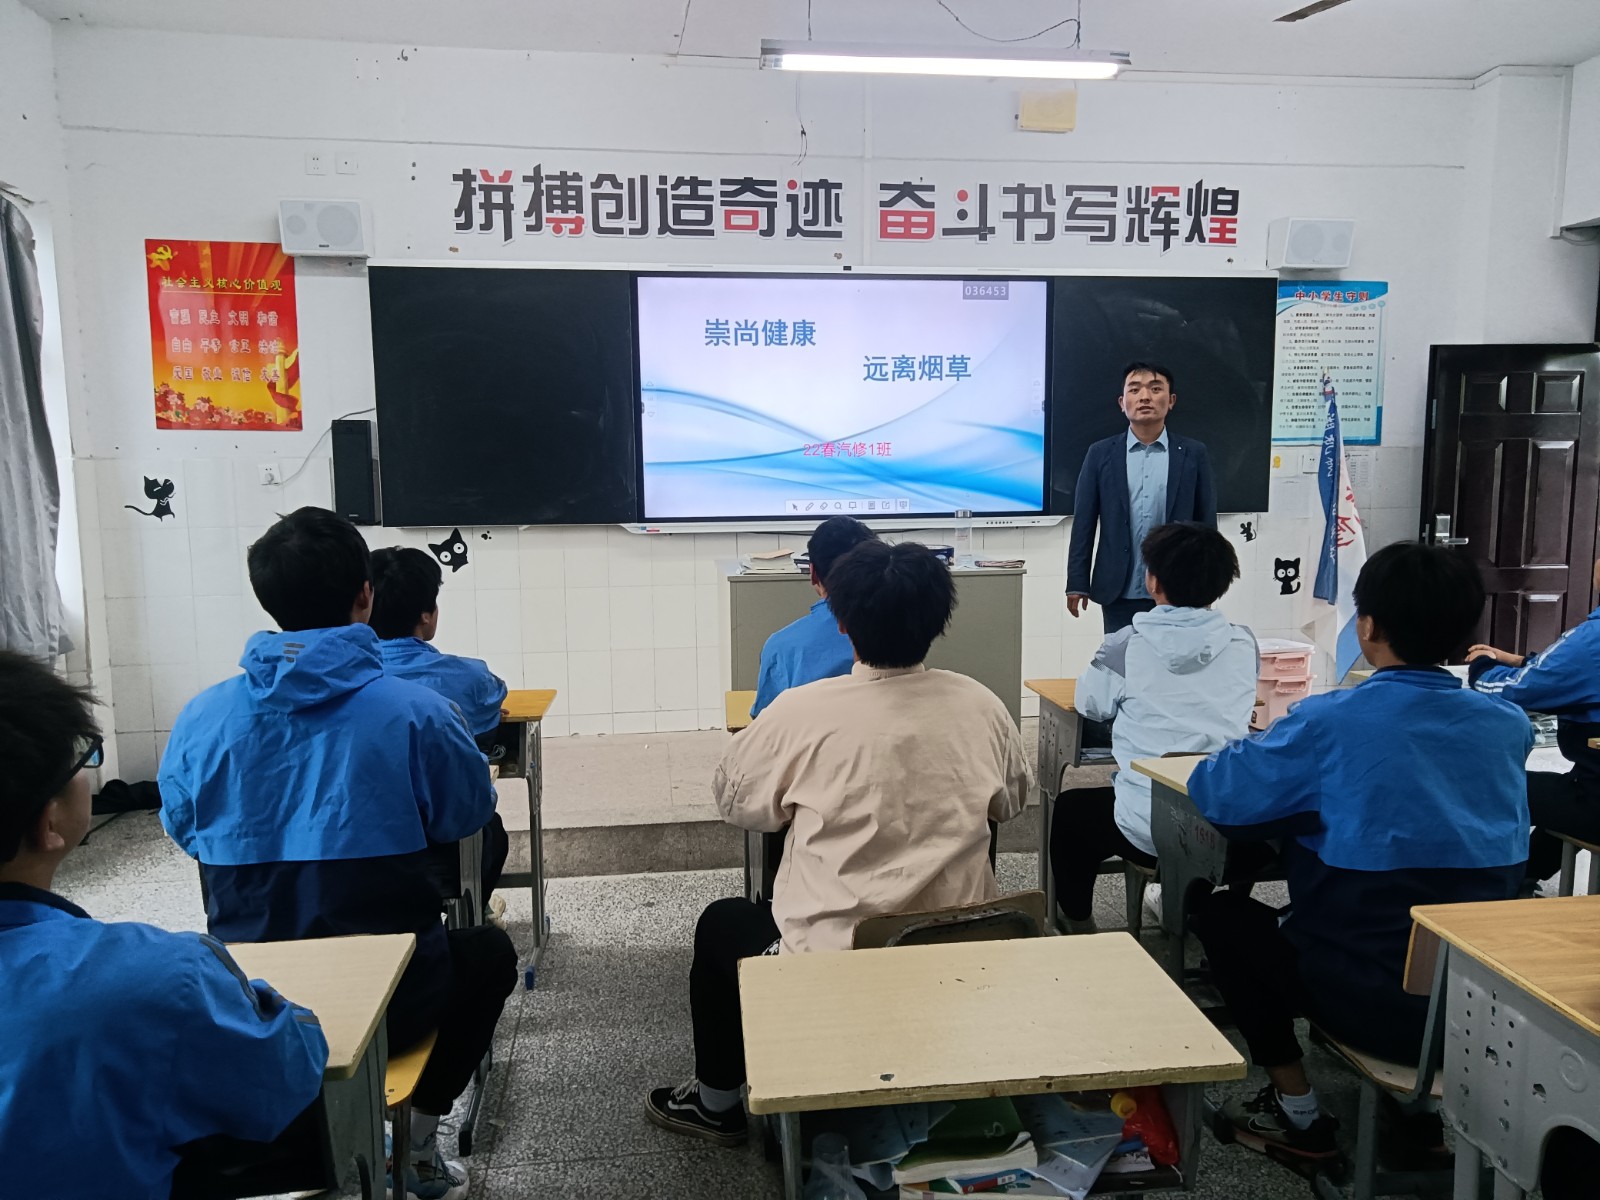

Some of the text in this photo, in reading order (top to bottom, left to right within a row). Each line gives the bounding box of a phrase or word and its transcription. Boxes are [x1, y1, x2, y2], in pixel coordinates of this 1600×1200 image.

[452, 163, 1240, 253] 拼搏创造奇迹 奋斗书写辉煌
[161, 276, 283, 292] 社会主义核心价值观
[965, 286, 1006, 296] 036453
[1295, 290, 1370, 302] 中小学生守则
[704, 319, 817, 347] 崇尚健康
[862, 354, 972, 382] 远离烟草
[803, 441, 892, 458] 22春汽修1班
